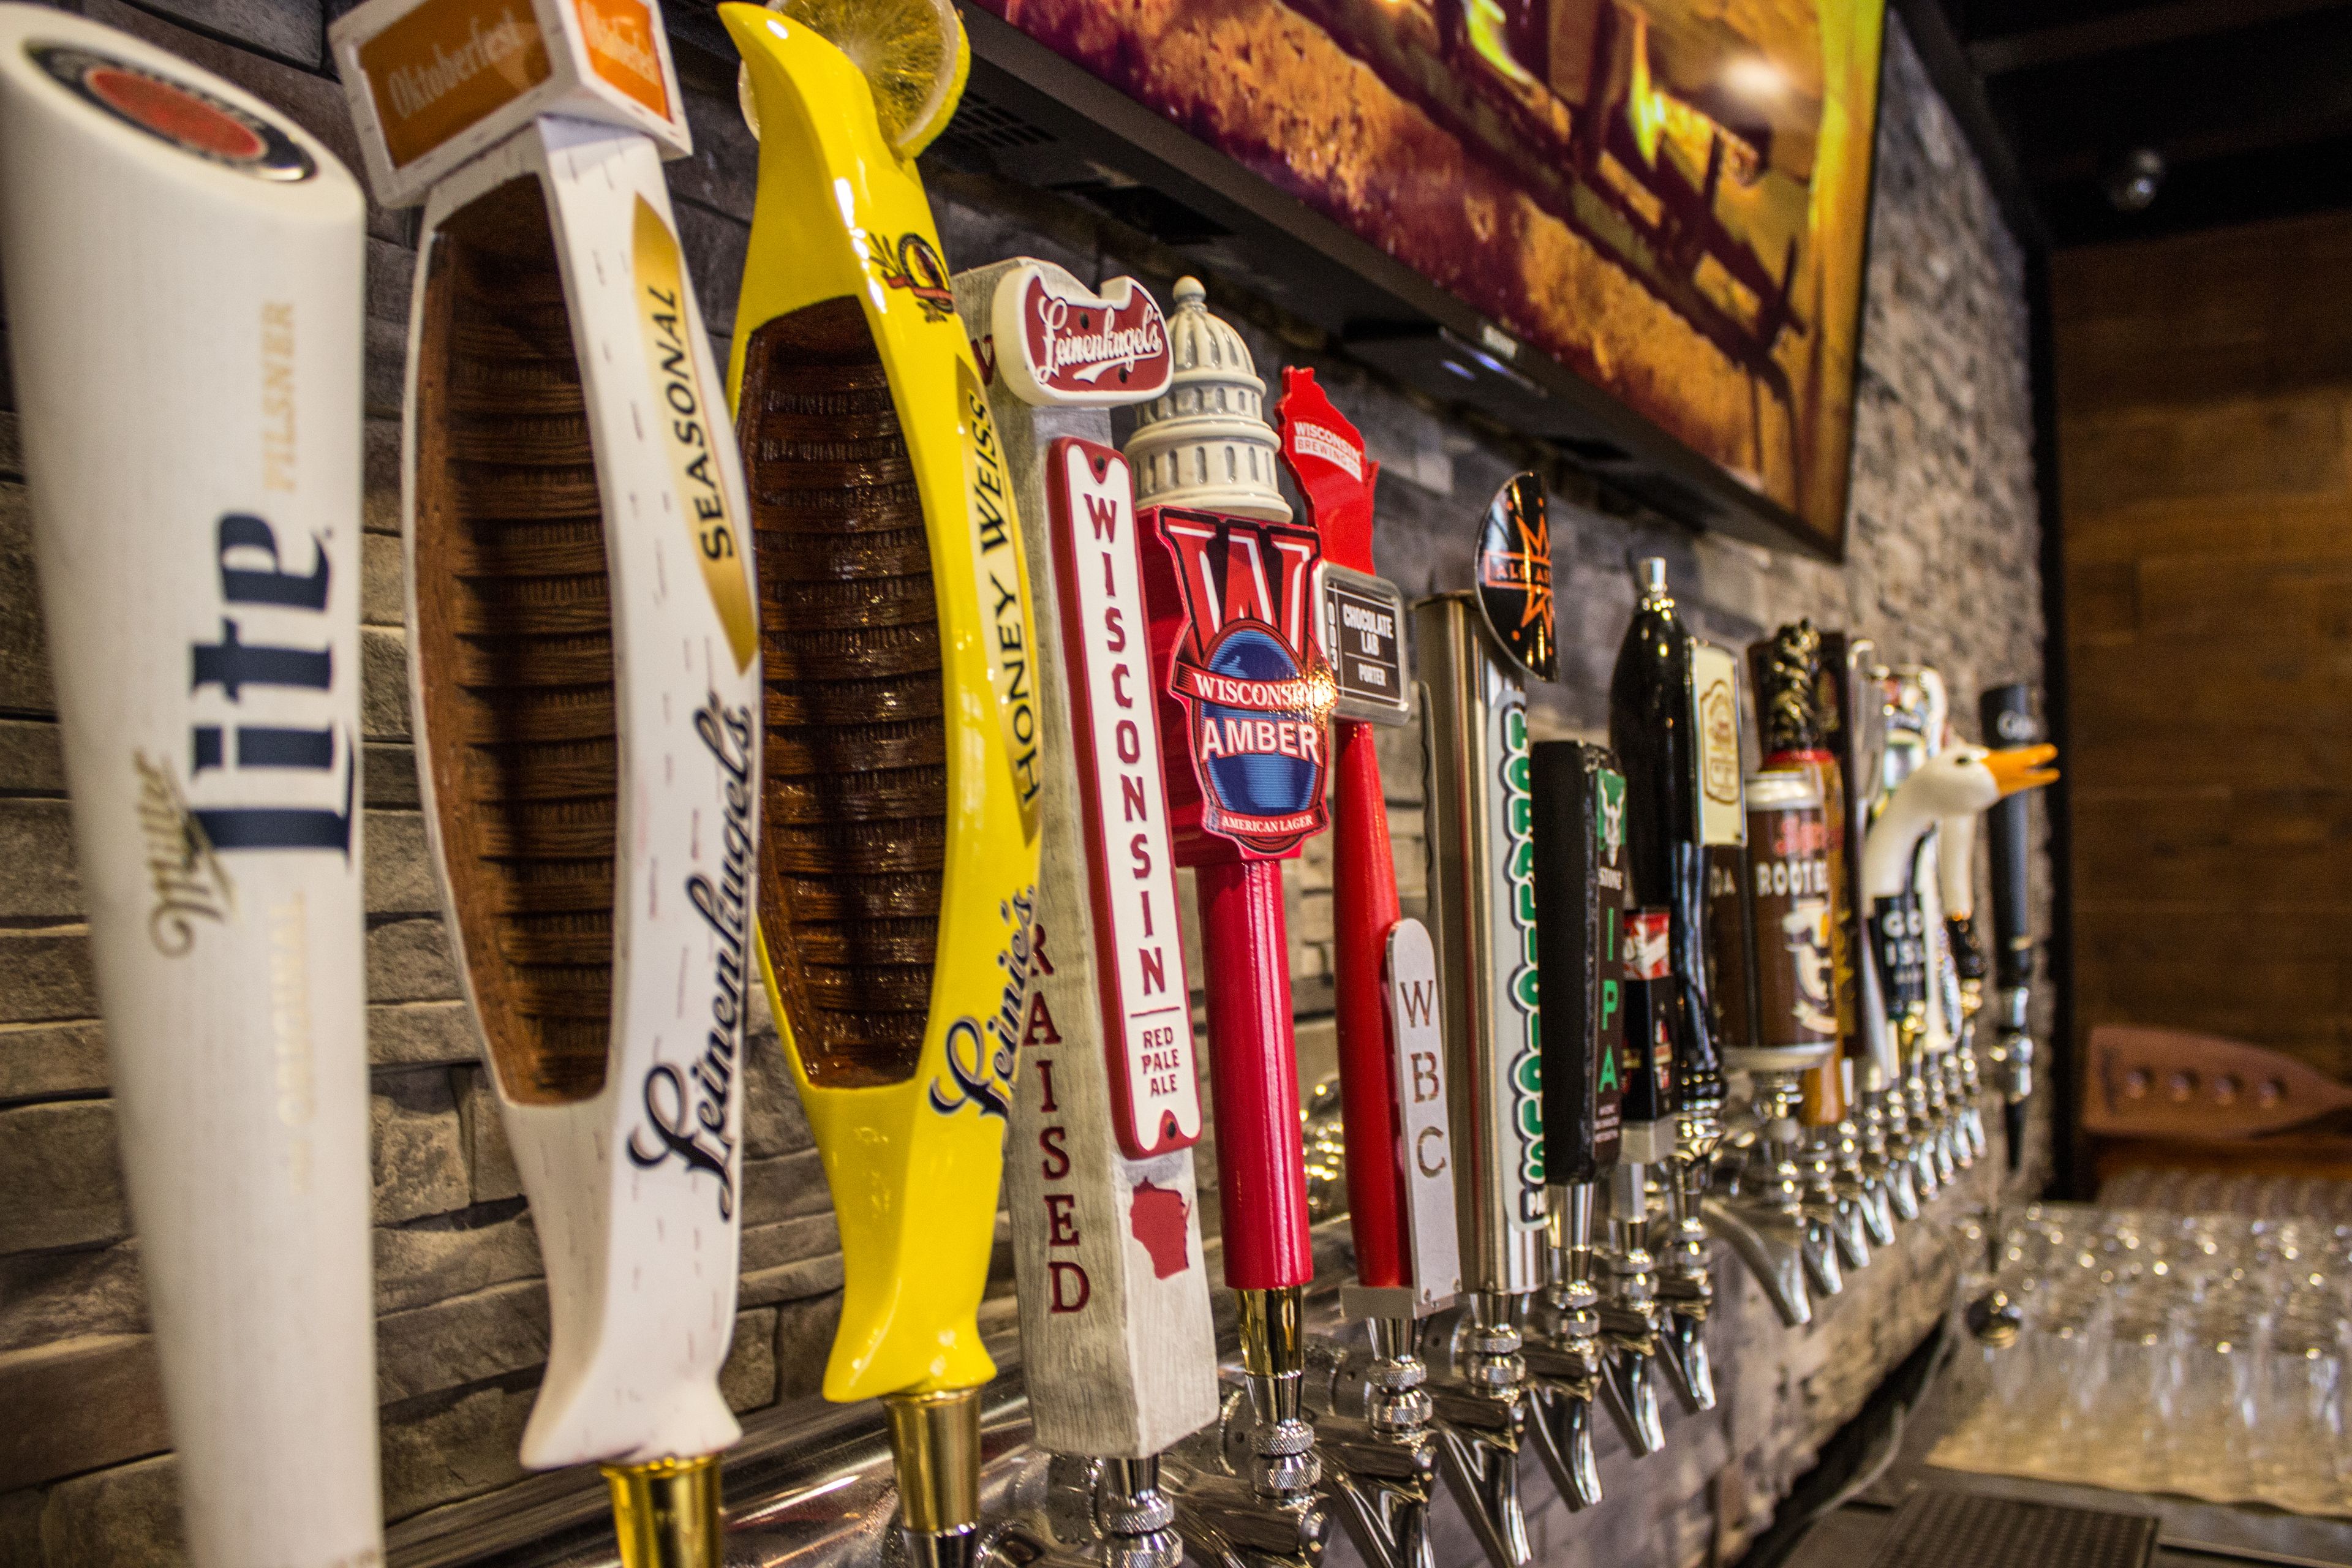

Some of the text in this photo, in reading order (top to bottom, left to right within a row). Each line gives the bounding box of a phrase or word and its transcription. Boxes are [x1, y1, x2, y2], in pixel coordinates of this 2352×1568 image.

[387, 7, 524, 120] Oktoberfest
[1038, 296, 1163, 385] Leinenkugel's
[261, 303, 296, 494] PILSNER
[648, 285, 733, 562] SEASONAL
[1294, 421, 1361, 464] WISCONSIN
[969, 392, 1009, 553] WEISS
[1342, 603, 1394, 639] CHOCOLATE
[1360, 630, 1379, 656] LAB
[990, 570, 1041, 807] HONEY
[1358, 663, 1386, 687] PORTER
[1084, 492, 1166, 995] WISCONSIN
[1201, 718, 1322, 766] AMBER
[131, 746, 238, 959] Miller
[1221, 815, 1314, 833] AMERICAN LAGER
[625, 690, 754, 1224] Leinenkugel's
[1597, 907, 1619, 1093] IPA
[1141, 1047, 1180, 1076] PALE
[1143, 1025, 1174, 1050] RED
[1150, 1072, 1178, 1098] ALE
[1400, 979, 1447, 1179] WBC
